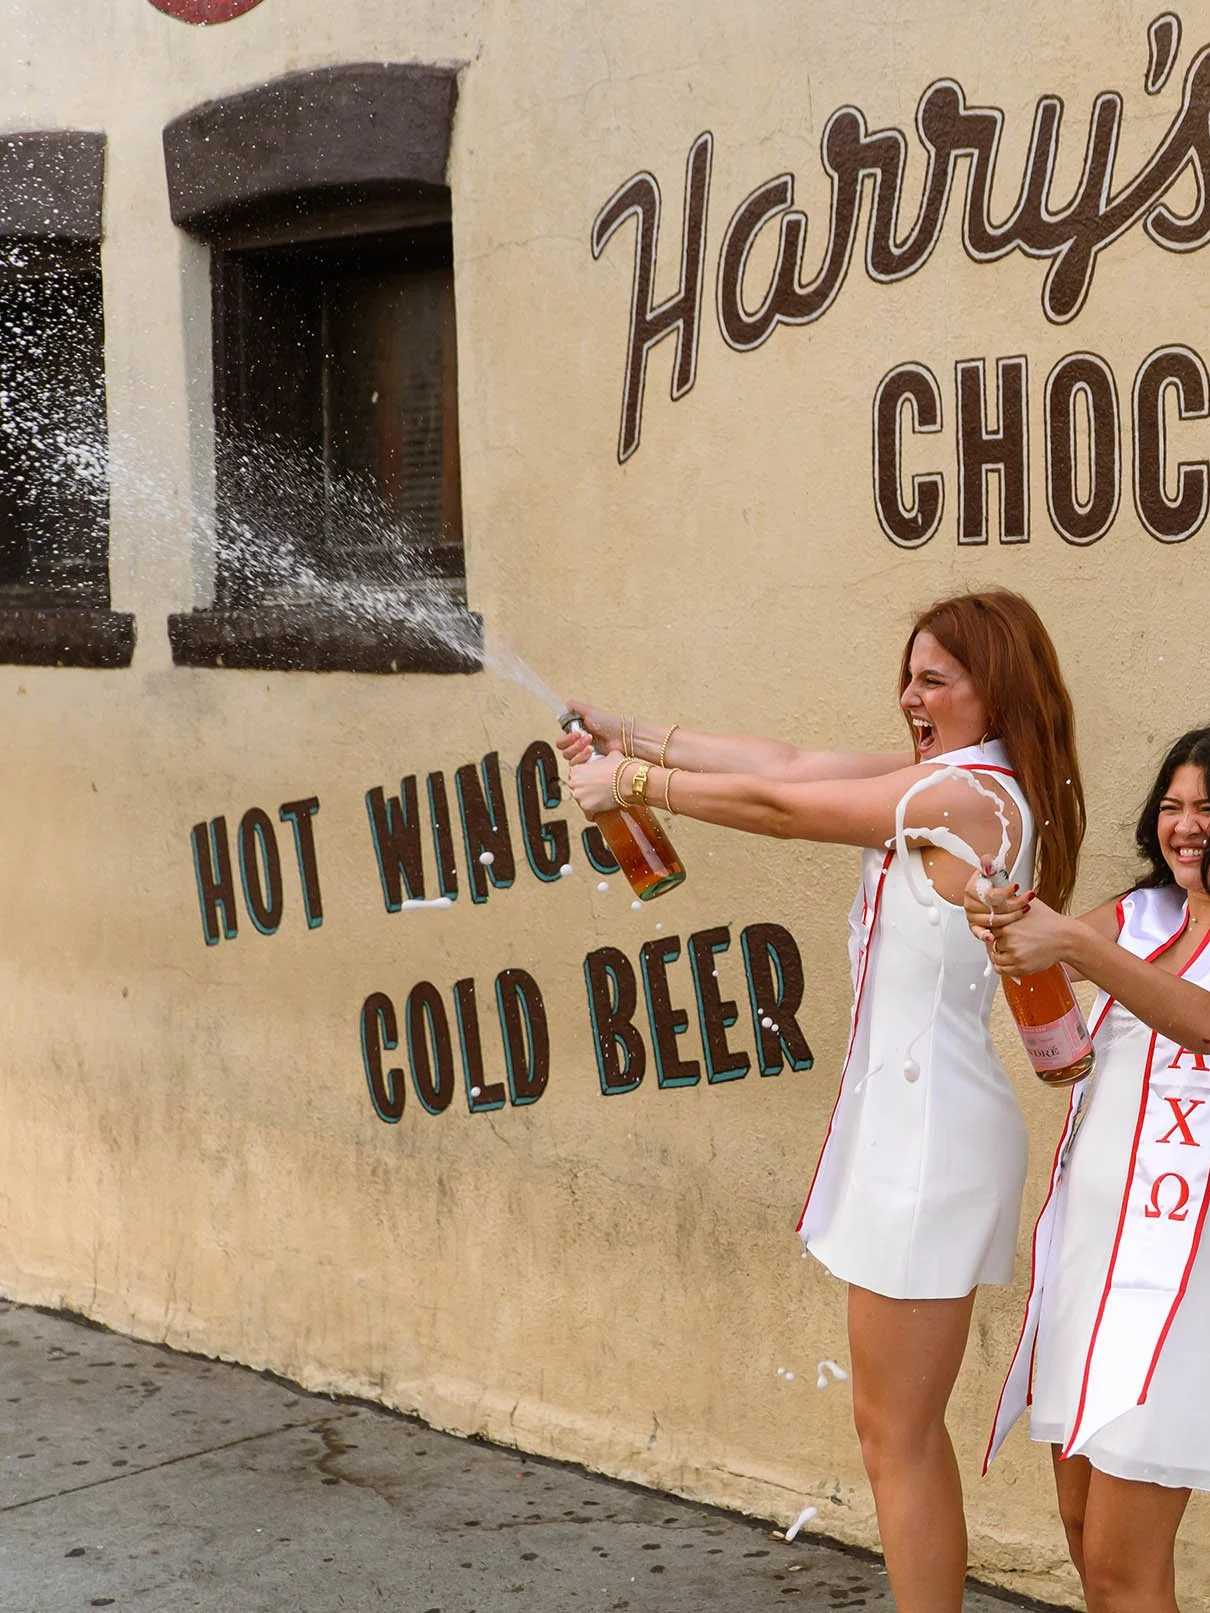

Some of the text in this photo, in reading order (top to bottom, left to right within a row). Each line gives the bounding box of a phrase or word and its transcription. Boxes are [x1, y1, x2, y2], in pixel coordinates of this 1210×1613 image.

[191, 796, 324, 946] HOT
[360, 967, 551, 1124] COLD
[583, 922, 814, 1096] BEER
